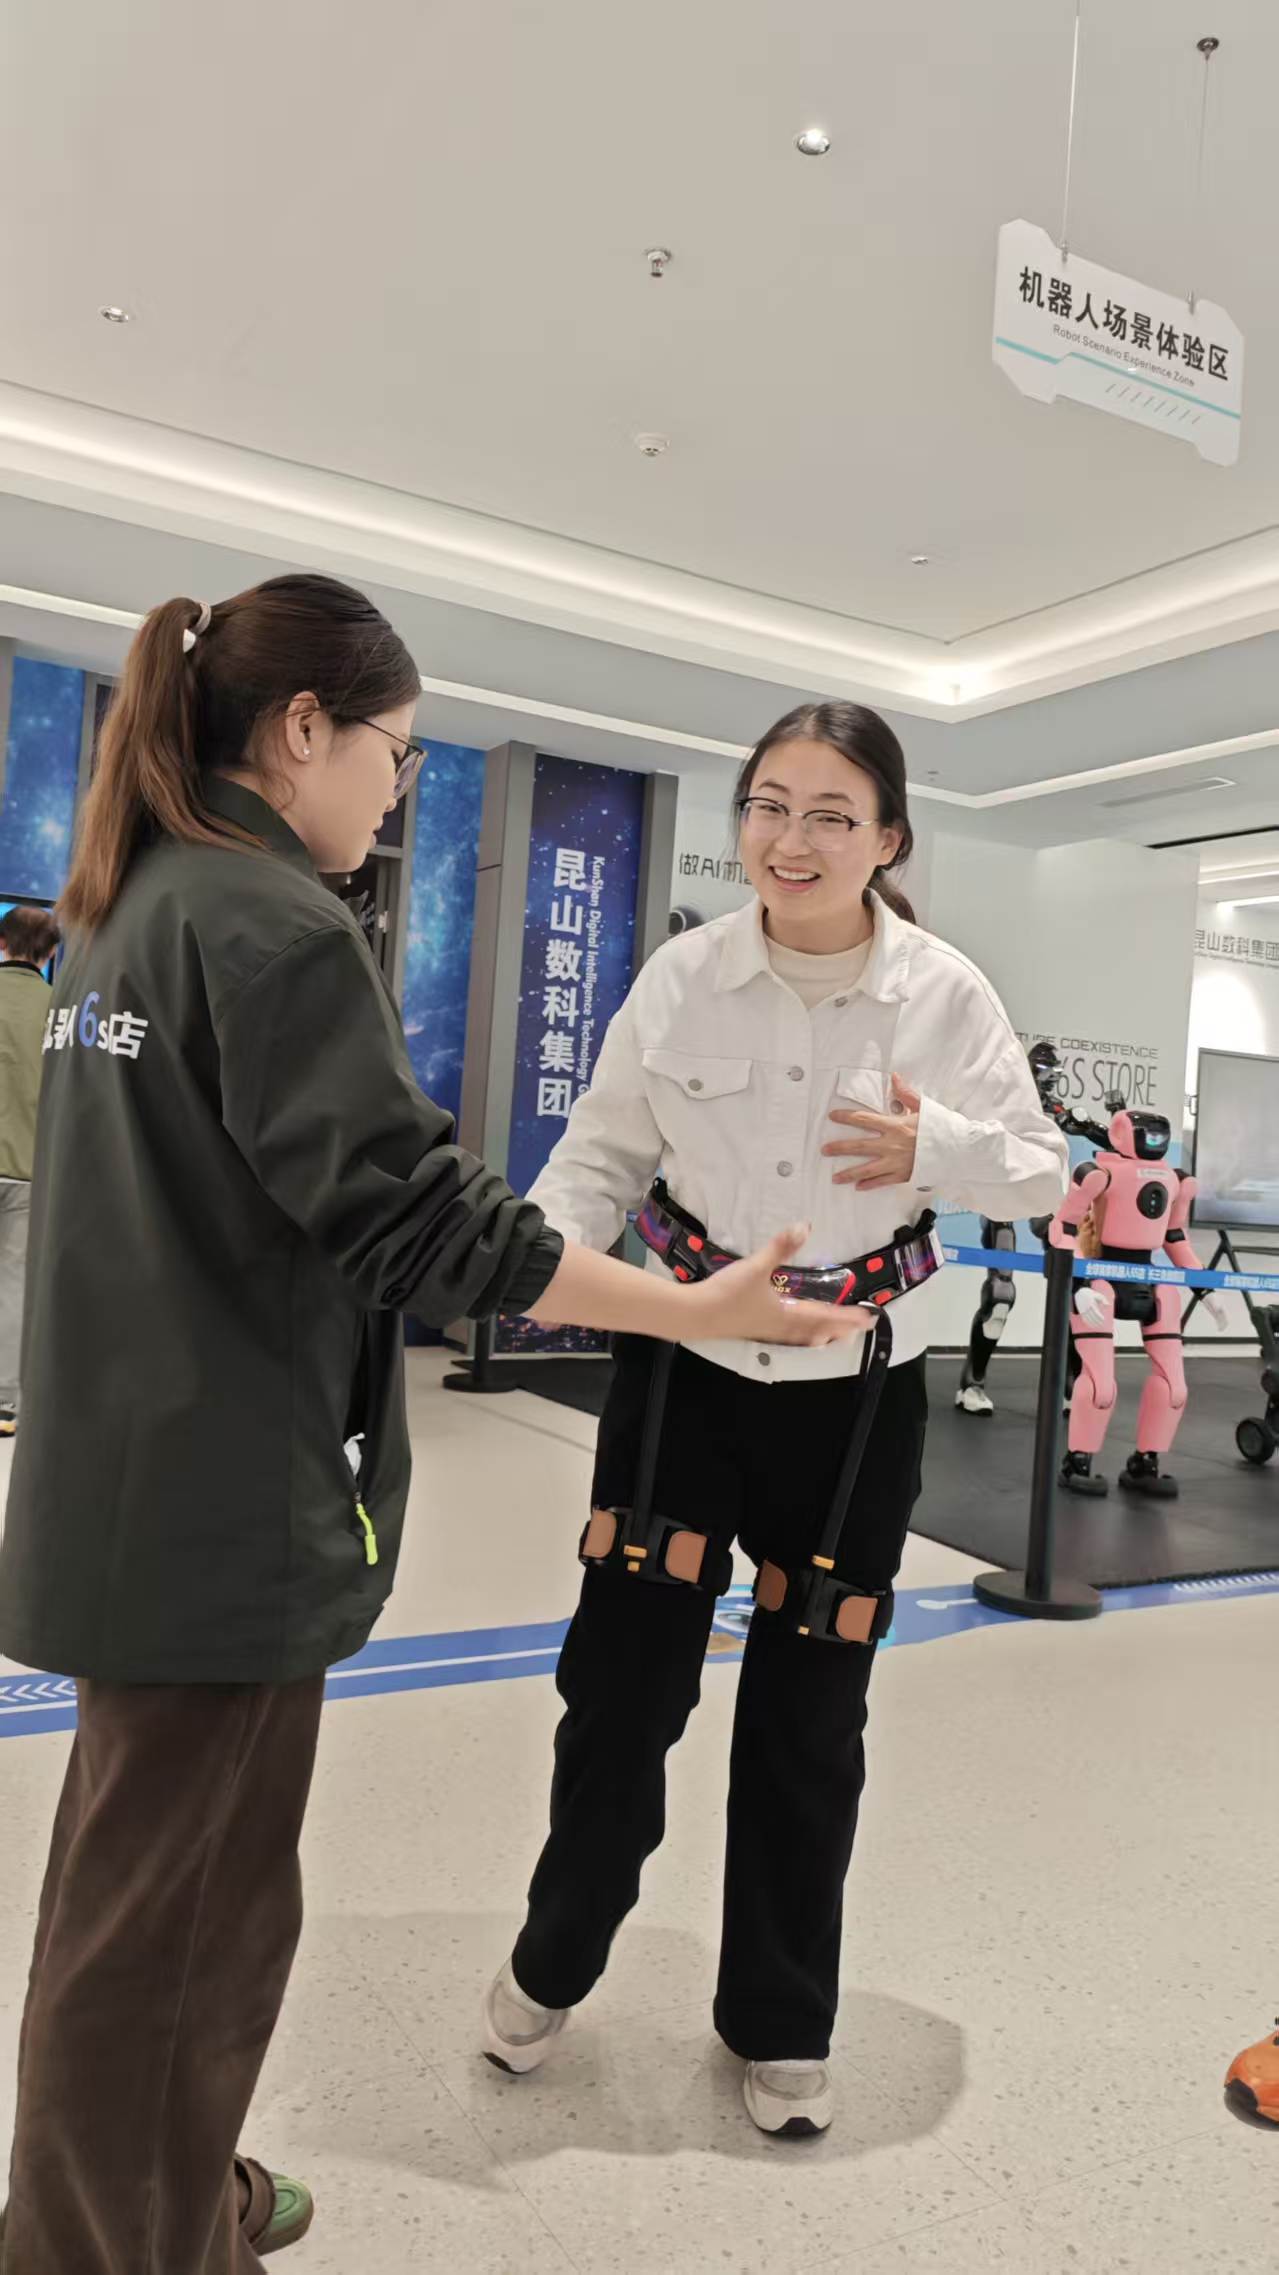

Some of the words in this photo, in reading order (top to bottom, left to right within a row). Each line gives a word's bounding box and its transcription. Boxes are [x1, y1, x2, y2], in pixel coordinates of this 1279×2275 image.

[1018, 265, 1230, 382] 机器人场景体验区
[1052, 323, 1082, 344] Robot
[1081, 335, 1123, 359] Scenario
[1122, 351, 1173, 379] Experience
[1173, 370, 1196, 388] Zone
[587, 855, 606, 908] KunShan
[679, 853, 753, 886] 做AI机
[585, 910, 602, 949] Digital
[536, 847, 587, 1118] 昆山数科集团
[582, 950, 600, 1016] Intelligence
[576, 1018, 595, 1082] Technology
[1060, 1037, 1159, 1060] COEXISTENCE
[1092, 1059, 1158, 1107] STORE
